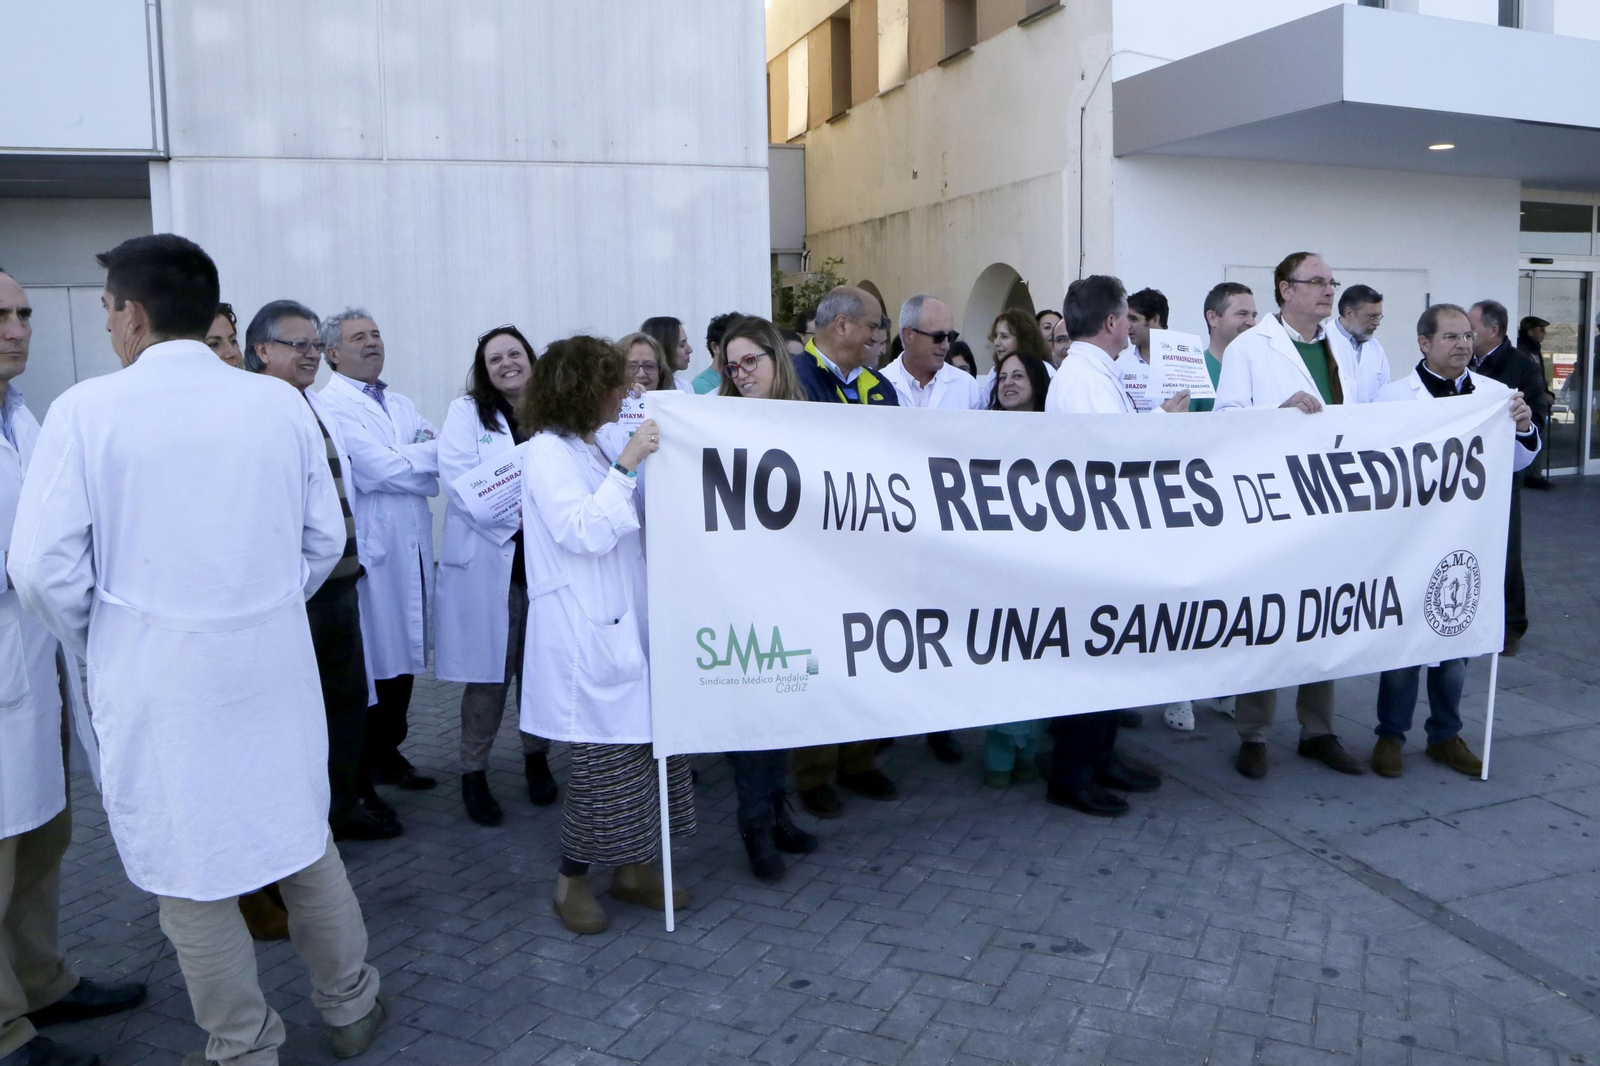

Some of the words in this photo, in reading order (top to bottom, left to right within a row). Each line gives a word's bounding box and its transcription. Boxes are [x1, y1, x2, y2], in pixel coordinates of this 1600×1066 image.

[702, 448, 802, 532] NO
[822, 471, 917, 533] MAS
[928, 457, 1224, 533] RECORTES
[1233, 474, 1293, 524] DE
[1285, 434, 1486, 516] MÉDICOS
[842, 606, 953, 677] POR
[966, 606, 1070, 666] UNA
[1084, 593, 1286, 658] SANIDAD
[1296, 576, 1403, 643] DIGNA
[1425, 568, 1443, 630] SINDICATO
[1439, 614, 1472, 635] MEDICO
[1469, 598, 1478, 615] DE
[696, 621, 812, 676] SMA
[699, 676, 740, 686] Sindicato
[742, 675, 774, 685] Médico
[775, 672, 809, 683] Andaluz
[775, 681, 808, 694] Cádiz
